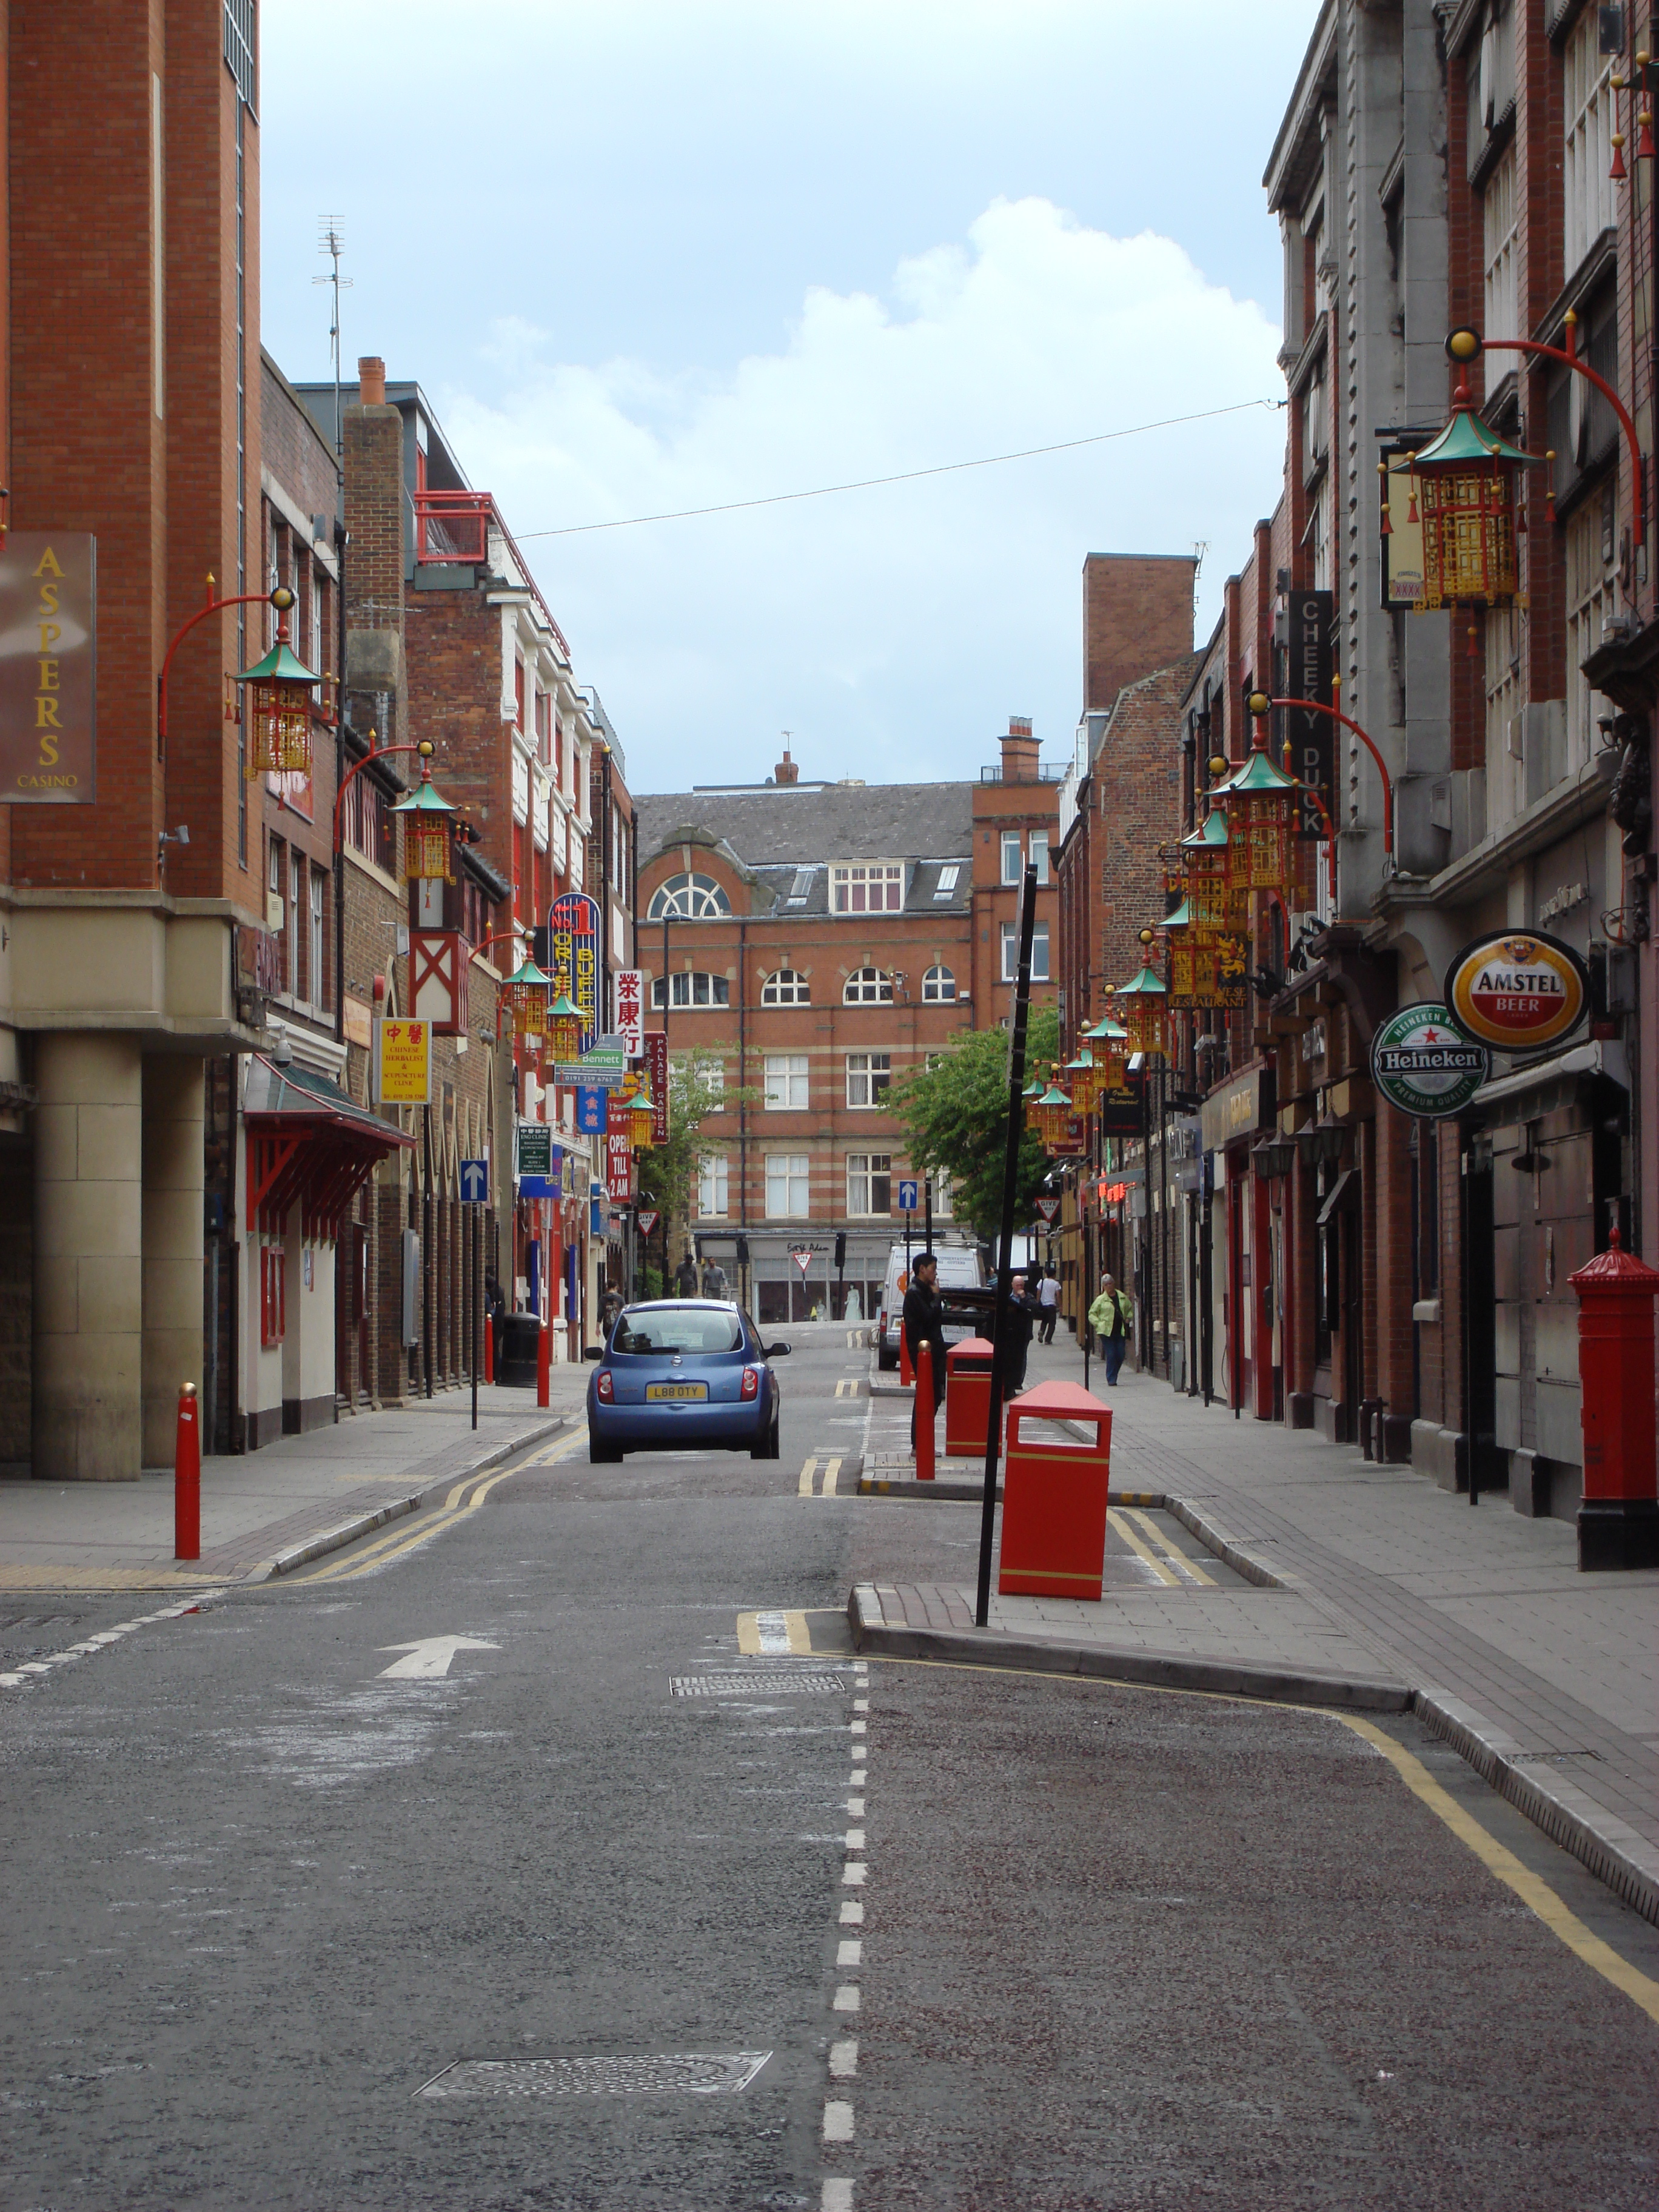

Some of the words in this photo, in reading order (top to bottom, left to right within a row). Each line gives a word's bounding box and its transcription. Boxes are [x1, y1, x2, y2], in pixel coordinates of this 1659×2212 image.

[33, 547, 65, 766] ASPERS
[1302, 600, 1319, 729] CHEEKY
[17, 774, 78, 788] CASINO
[1303, 748, 1321, 833] DUCK
[551, 916, 575, 929] No.
[572, 900, 595, 935] 1
[577, 948, 595, 1033] BUFFET
[1217, 987, 1247, 997] NESE
[1478, 971, 1560, 993] AMSTEL
[1168, 997, 1247, 1008] RESTAURANT
[1496, 997, 1540, 1012] BEER
[387, 1024, 423, 1044] 中醫
[1394, 1013, 1441, 1037] HEINEKEN
[582, 1054, 620, 1064] Bennett
[1386, 1050, 1478, 1069] Heineken
[1393, 1082, 1433, 1107] PREMIUM
[1437, 1079, 1472, 1106] QUALITY
[609, 1134, 634, 1154] OPEN
[613, 1156, 628, 1175] TILL
[610, 1178, 616, 1197] 2
[616, 1178, 628, 1197] AM
[654, 1387, 675, 1397] L88
